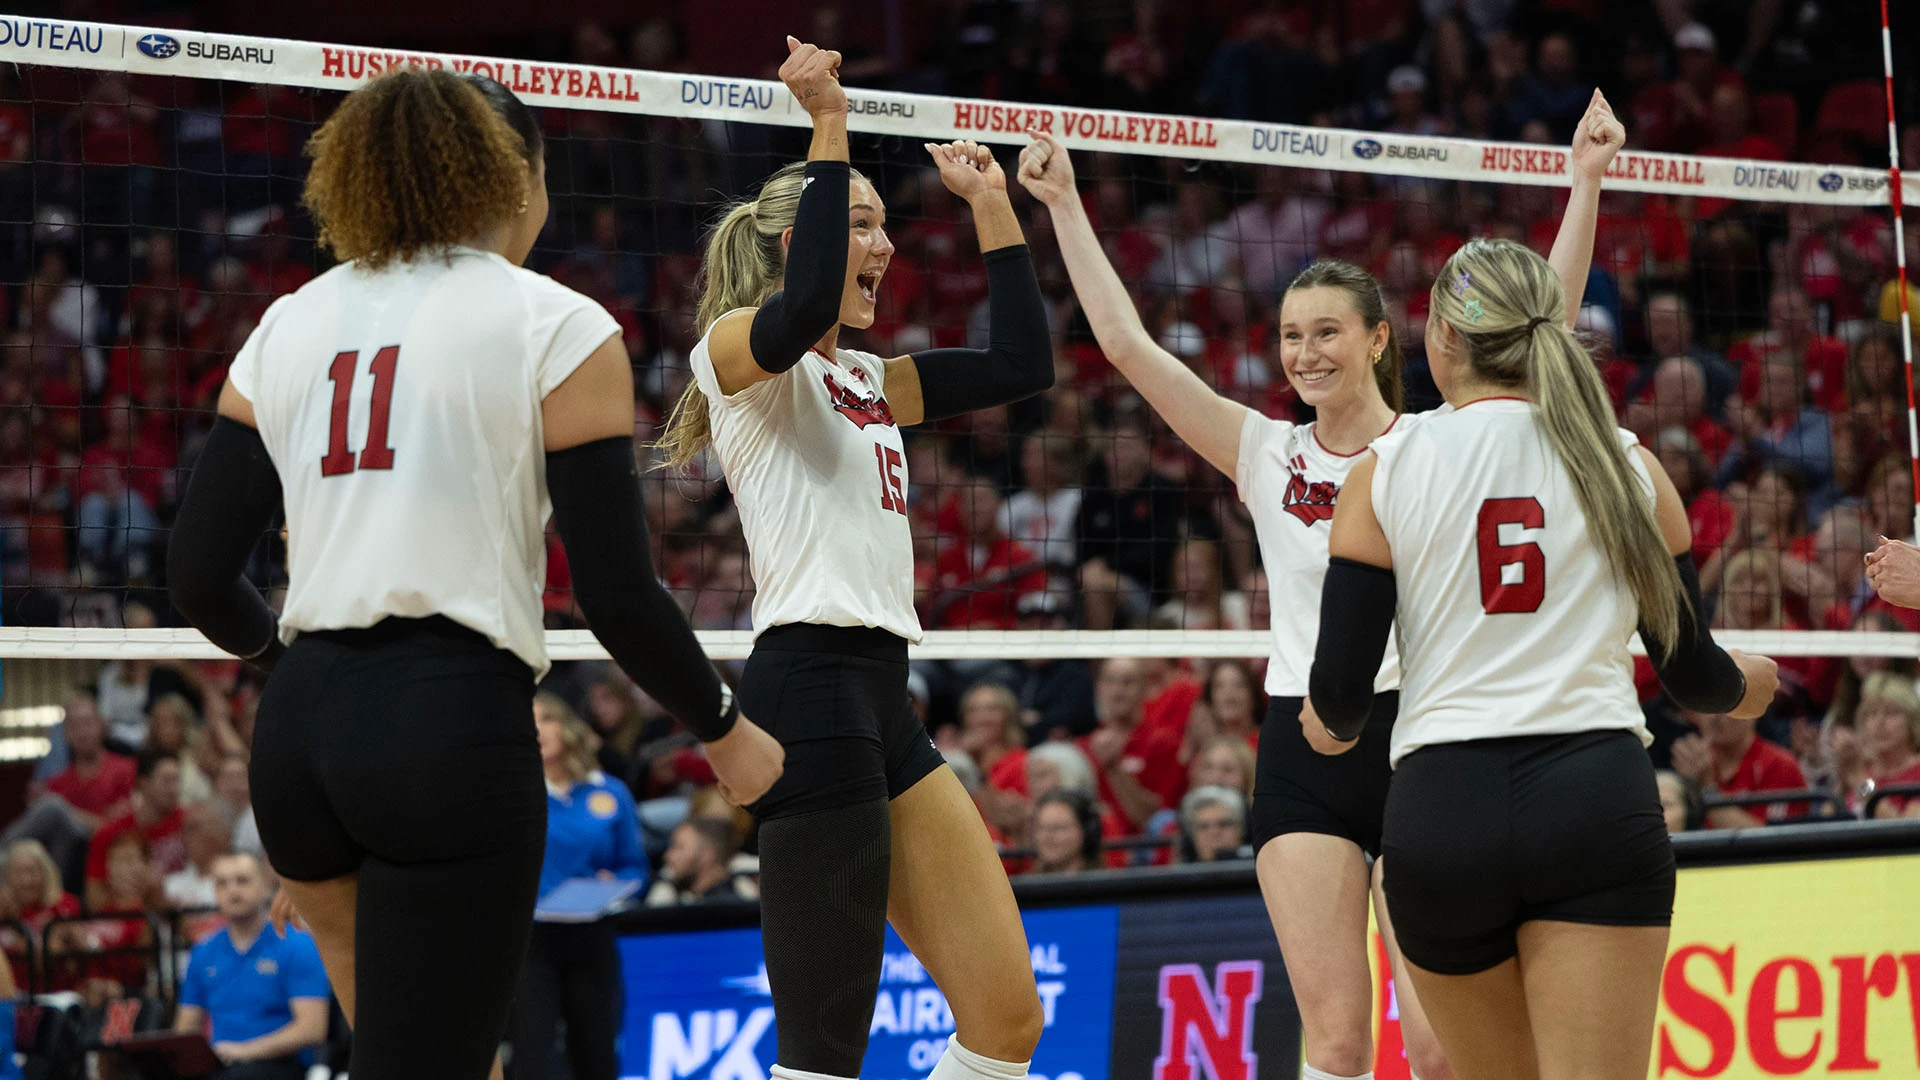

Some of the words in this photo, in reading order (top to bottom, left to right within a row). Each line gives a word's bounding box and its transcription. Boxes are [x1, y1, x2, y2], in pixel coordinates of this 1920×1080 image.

[187, 41, 275, 65] SUBARU
[681, 80, 773, 110] DUTEAU
[953, 102, 1054, 135] HUSKER
[1061, 111, 1217, 148] VOLLEYBALL
[1251, 128, 1328, 157] DUTEAU
[1385, 144, 1448, 162] SUBARU
[1480, 146, 1567, 175] HUSKER
[1603, 155, 1705, 185] LLEYBALL
[1734, 165, 1800, 190] DUTEAU
[320, 344, 401, 478] 11
[875, 442, 907, 516] 15
[1477, 496, 1546, 615] 6
[1153, 960, 1264, 1080] N
